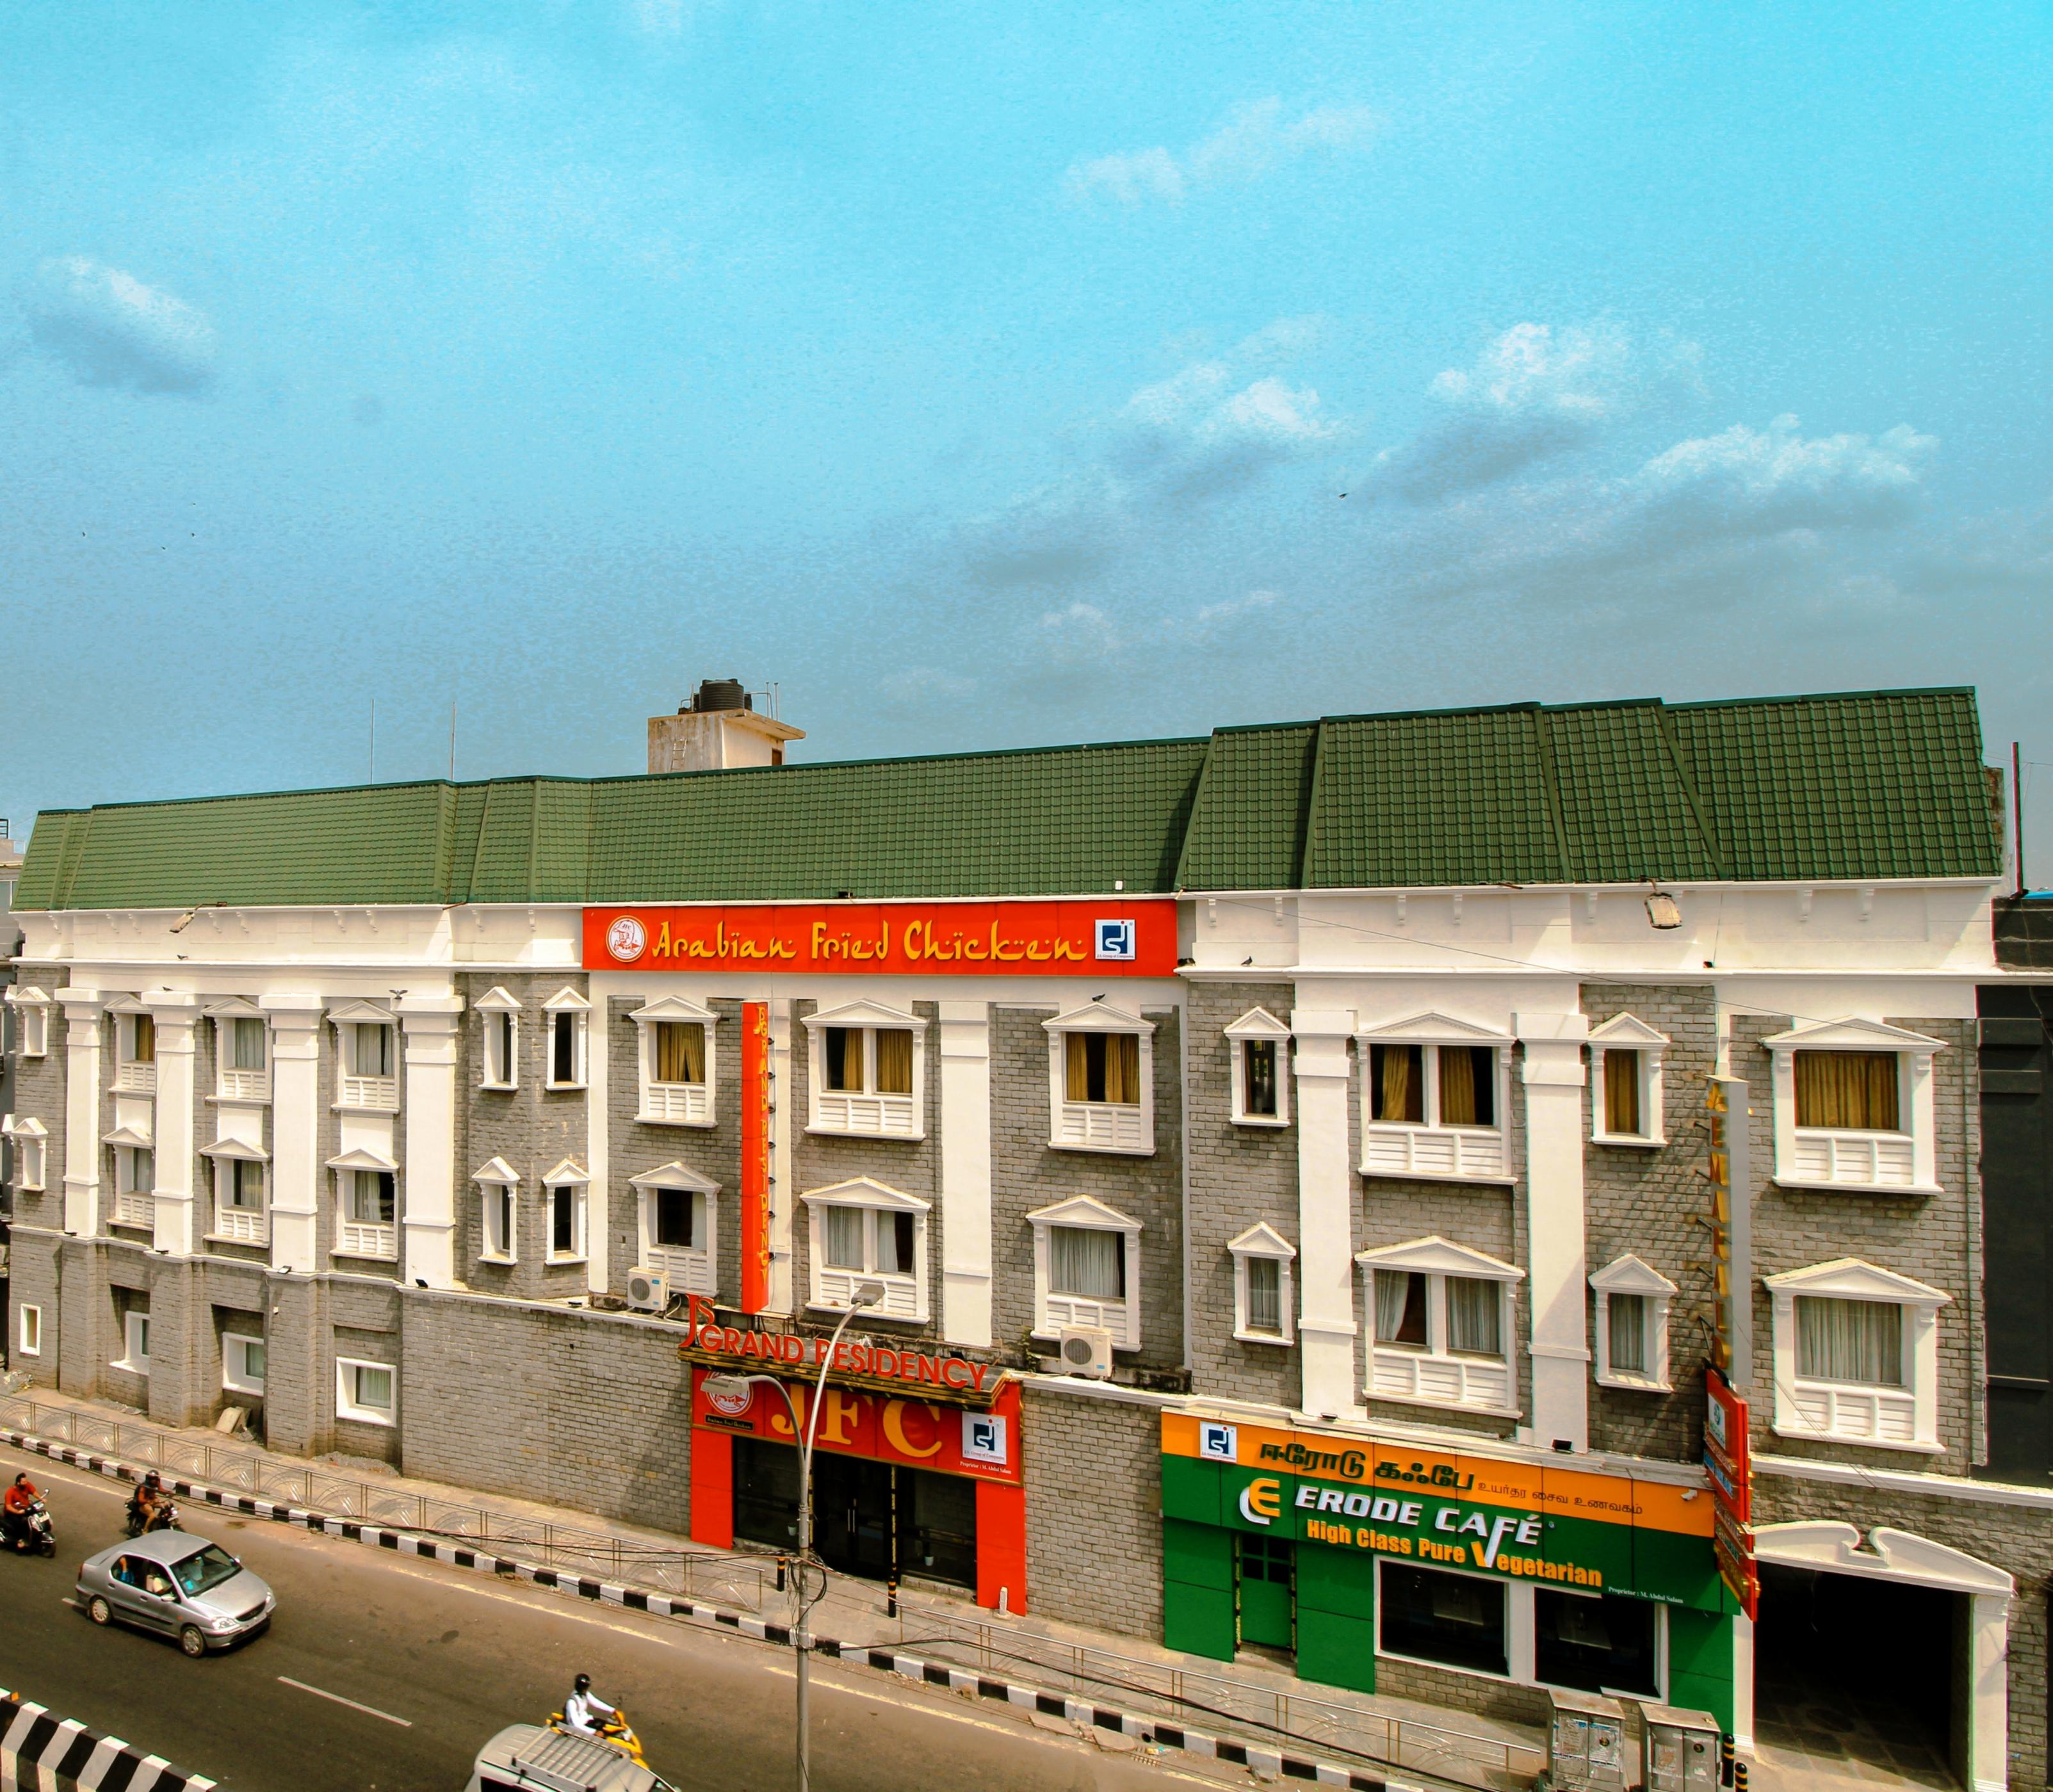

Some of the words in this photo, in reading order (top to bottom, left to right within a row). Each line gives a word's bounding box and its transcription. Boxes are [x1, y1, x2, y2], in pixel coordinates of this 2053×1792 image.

[758, 1021, 768, 1111] GRAND
[757, 1118, 768, 1286] RESIDENCY
[699, 1325, 804, 1363] GRAND
[815, 1338, 988, 1392] RESIDENCY
[771, 1384, 942, 1458] JFC
[1260, 1442, 1367, 1479] ஈரோடு
[1375, 1460, 1475, 1491] கஃபே
[1478, 1482, 1527, 1499] உயர்தர
[1532, 1491, 1568, 1504] சைவ
[1574, 1497, 1643, 1515] உணவகம்
[1295, 1484, 1424, 1526] ERODE
[1434, 1506, 1543, 1568] CAFÉ
[1307, 1519, 1352, 1545] High
[1356, 1528, 1412, 1554] Class
[1418, 1537, 1466, 1564] Pure
[1471, 1541, 1602, 1587] Vegetarian
[1608, 1586, 1635, 1595] Proprietor
[1666, 1595, 1684, 1604] Salam
